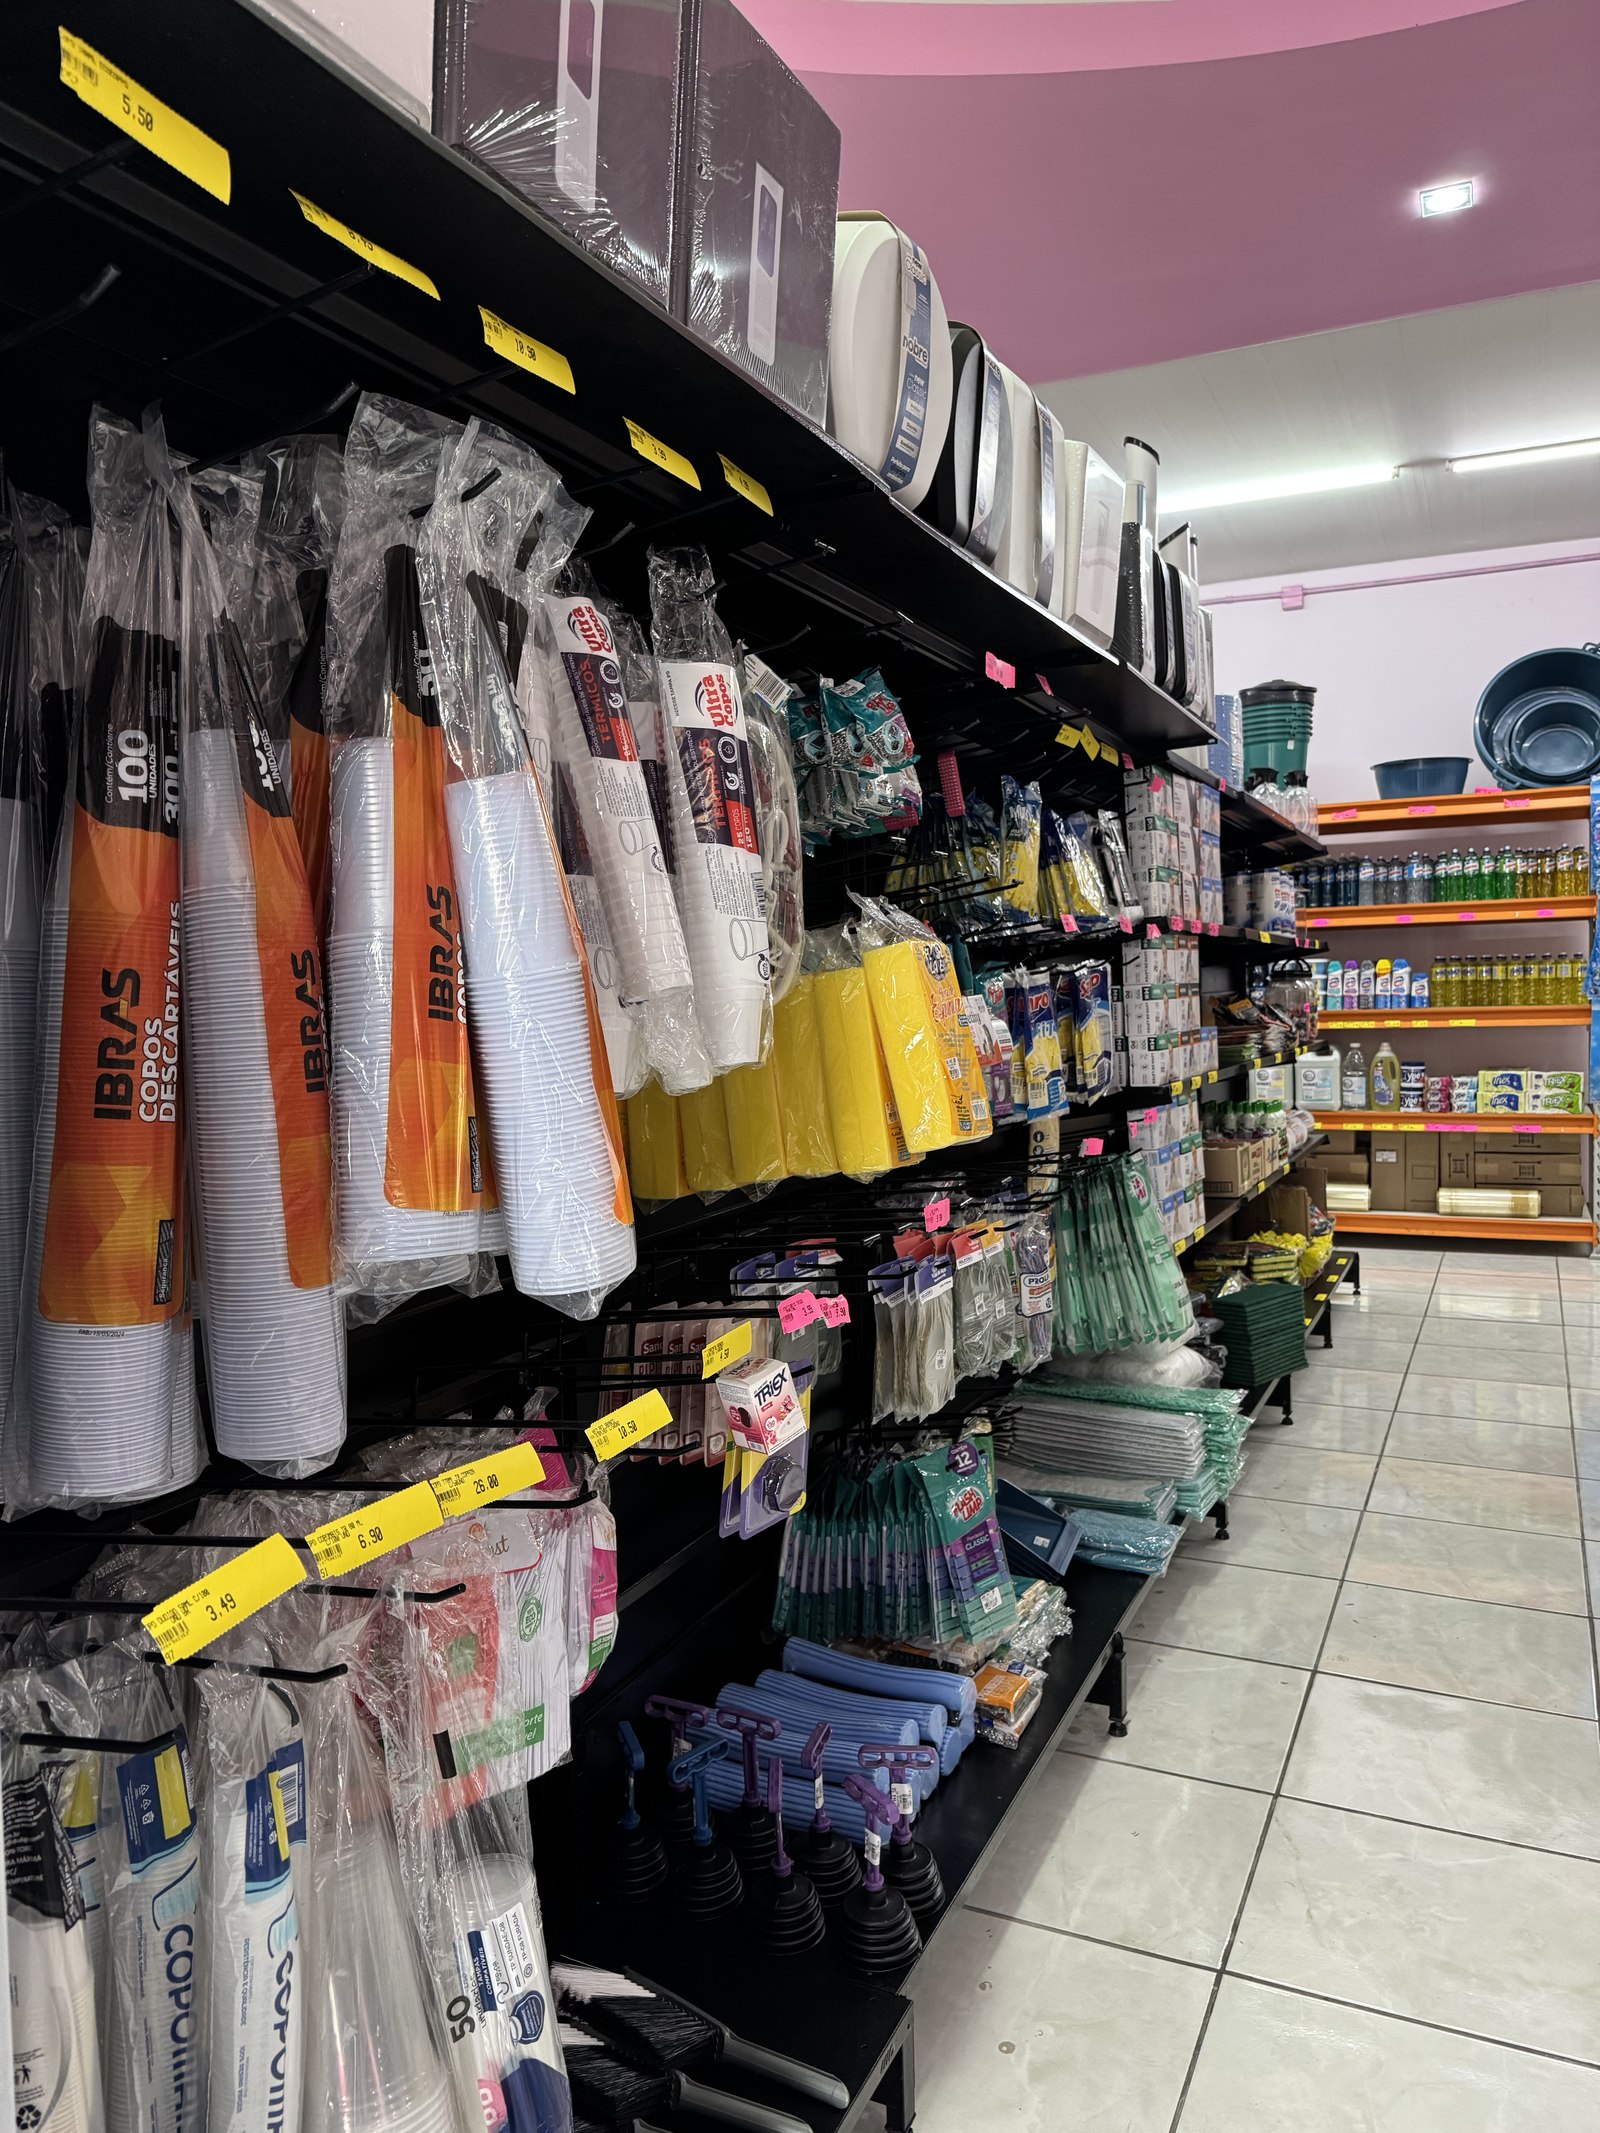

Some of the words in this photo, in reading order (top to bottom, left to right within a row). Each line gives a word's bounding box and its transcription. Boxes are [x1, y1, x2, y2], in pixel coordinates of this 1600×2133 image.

[121, 93, 154, 132] 5.50
[902, 333, 928, 364] nobre
[572, 605, 603, 652] Ultra
[585, 605, 613, 653] Copos
[579, 658, 611, 745] TÉRMICOS
[702, 674, 726, 728] Ultra
[716, 673, 734, 727] Copos
[104, 723, 115, 805] Contém/Contiene
[116, 728, 149, 804] 100
[148, 743, 157, 799] UNIDADES
[258, 727, 282, 785] UNIDADES
[732, 808, 742, 831] COPOS
[736, 830, 745, 845] 25
[425, 884, 455, 1024] IBRAS
[158, 900, 181, 1123] DESCARTÁVEIS
[290, 949, 326, 1094] IBRAS
[93, 967, 141, 1120] IBRAS
[138, 1017, 163, 1123] COPOS
[617, 1419, 638, 1440] 10.50
[954, 1451, 973, 1469] 12
[473, 1473, 500, 1495] 26.00
[952, 1487, 976, 1517] FLASH
[961, 1496, 983, 1522] LIMP
[357, 1526, 384, 1549] 6.90
[964, 1534, 990, 1552] CLASSIC
[205, 1592, 237, 1622] 3.49
[164, 1649, 175, 1662] 97
[499, 1921, 513, 1965] SUNDAE-08
[512, 1911, 524, 1941] FURADA
[474, 1955, 486, 1987] TAMPAS
[477, 1946, 493, 1997] COMPATÍVEIS
[445, 1994, 476, 2044] 50
